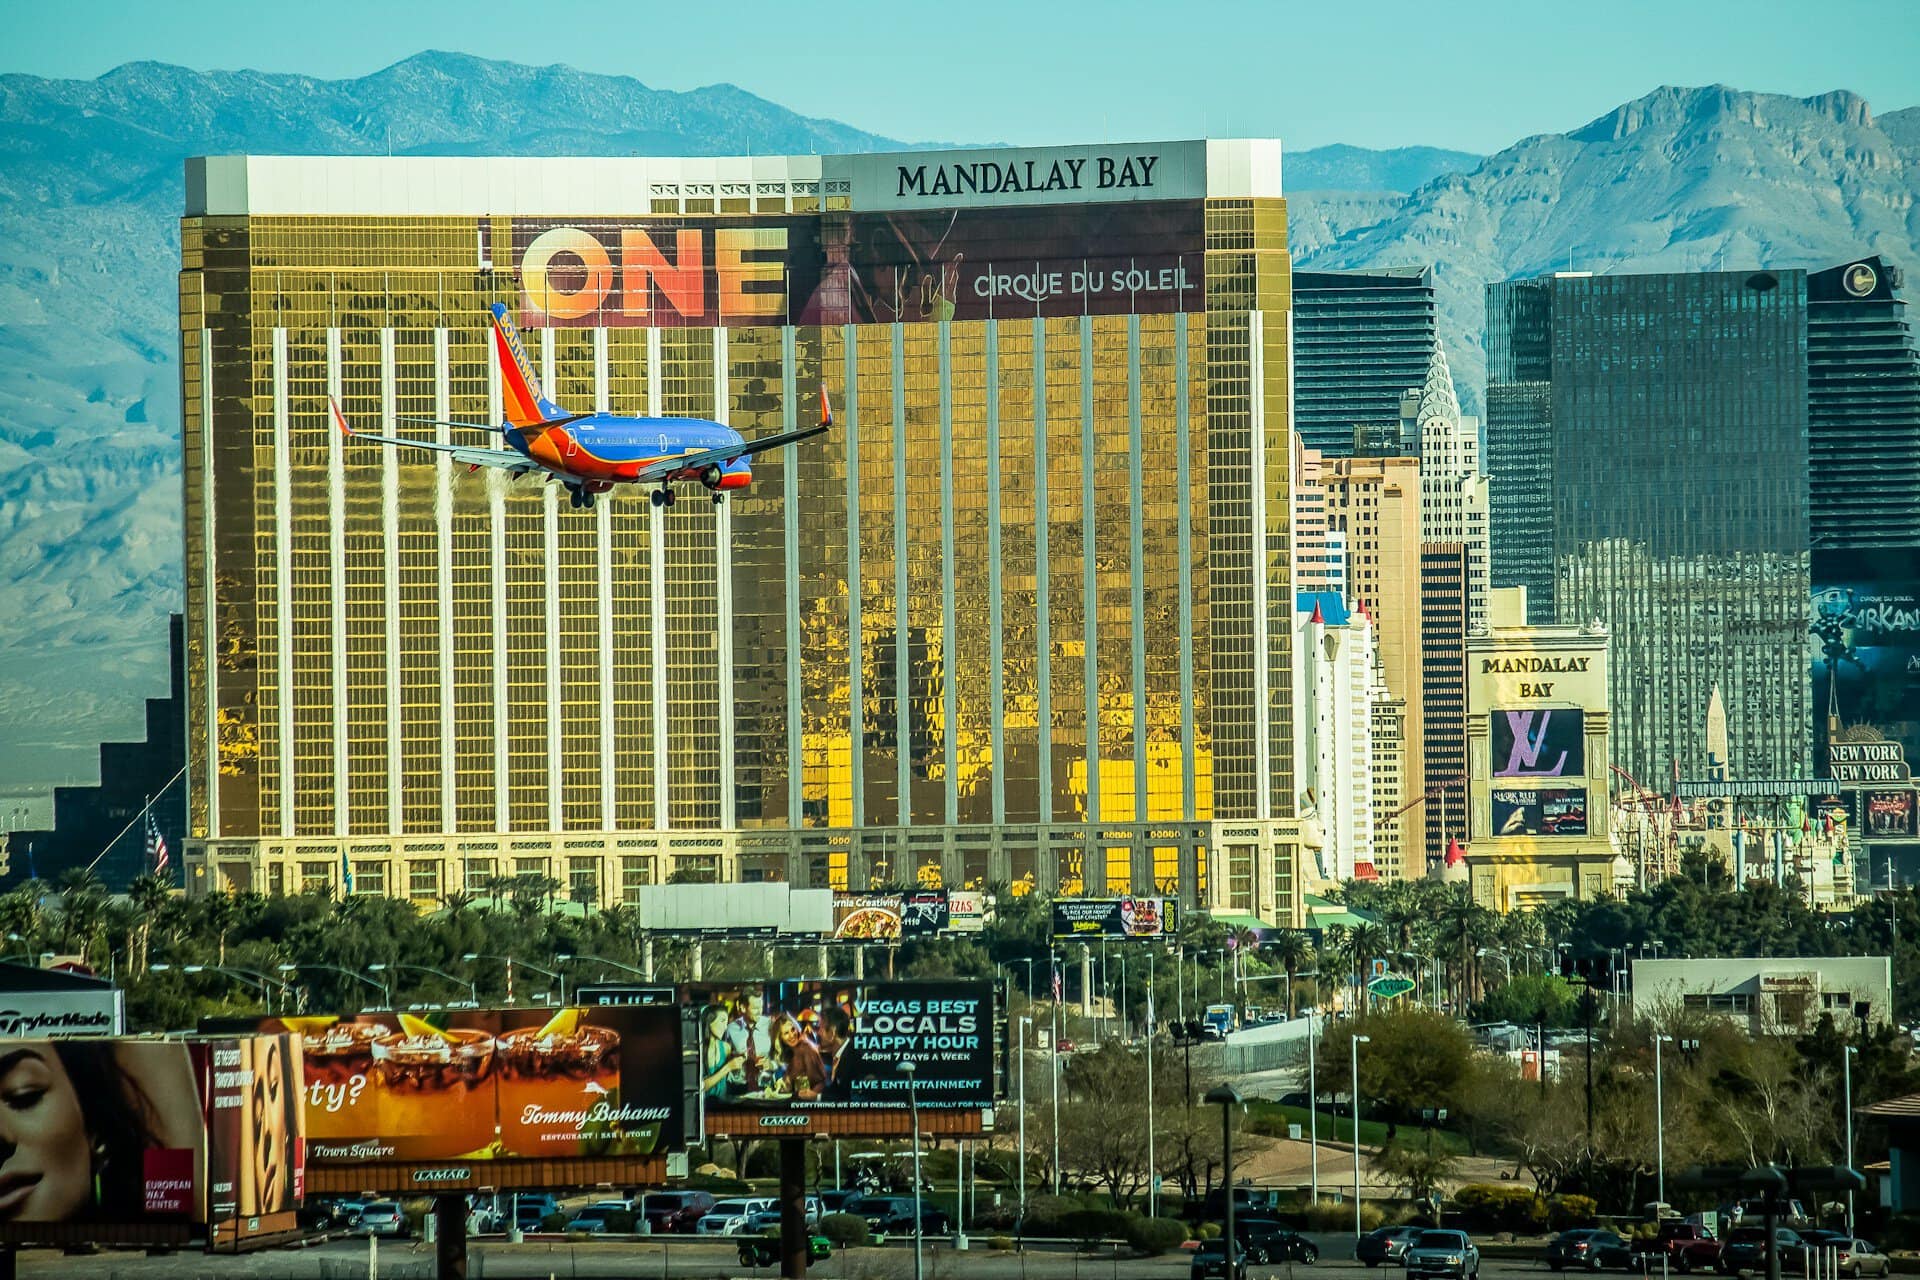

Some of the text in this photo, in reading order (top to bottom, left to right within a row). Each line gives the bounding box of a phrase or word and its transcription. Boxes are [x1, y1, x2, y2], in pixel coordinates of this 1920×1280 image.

[896, 156, 1160, 197] MANDALAY BAY
[521, 227, 789, 319] ONE
[974, 267, 1195, 302] CIRQUE DU SOLEIL
[500, 312, 544, 404] SOUTHWEST
[1481, 657, 1591, 674] MANDALAY
[1519, 682, 1555, 698] BAY
[1830, 745, 1899, 761] NEW YORK
[1830, 764, 1899, 780] NEW YORK
[855, 897, 900, 909] Creativity
[854, 1000, 979, 1014] VEGAS BEST
[855, 1016, 977, 1034] LOCALS
[853, 1035, 979, 1049] HAPPY HOUR
[894, 1053, 901, 1061] 7
[851, 1079, 981, 1089] LIVE ENTERTAINMENT
[912, 1101, 957, 1109] SPECIALLY
[520, 1101, 671, 1131] Tommy Bahama
[764, 1116, 805, 1126] LAMAR
[540, 1130, 652, 1142] RESTAURANT BAR STORE
[315, 1144, 395, 1161] Town Square
[416, 1169, 467, 1180] LAMAR
[145, 1180, 192, 1190] EUROPEAN
[145, 1190, 165, 1199] WAX
[145, 1200, 181, 1209] CENTER
